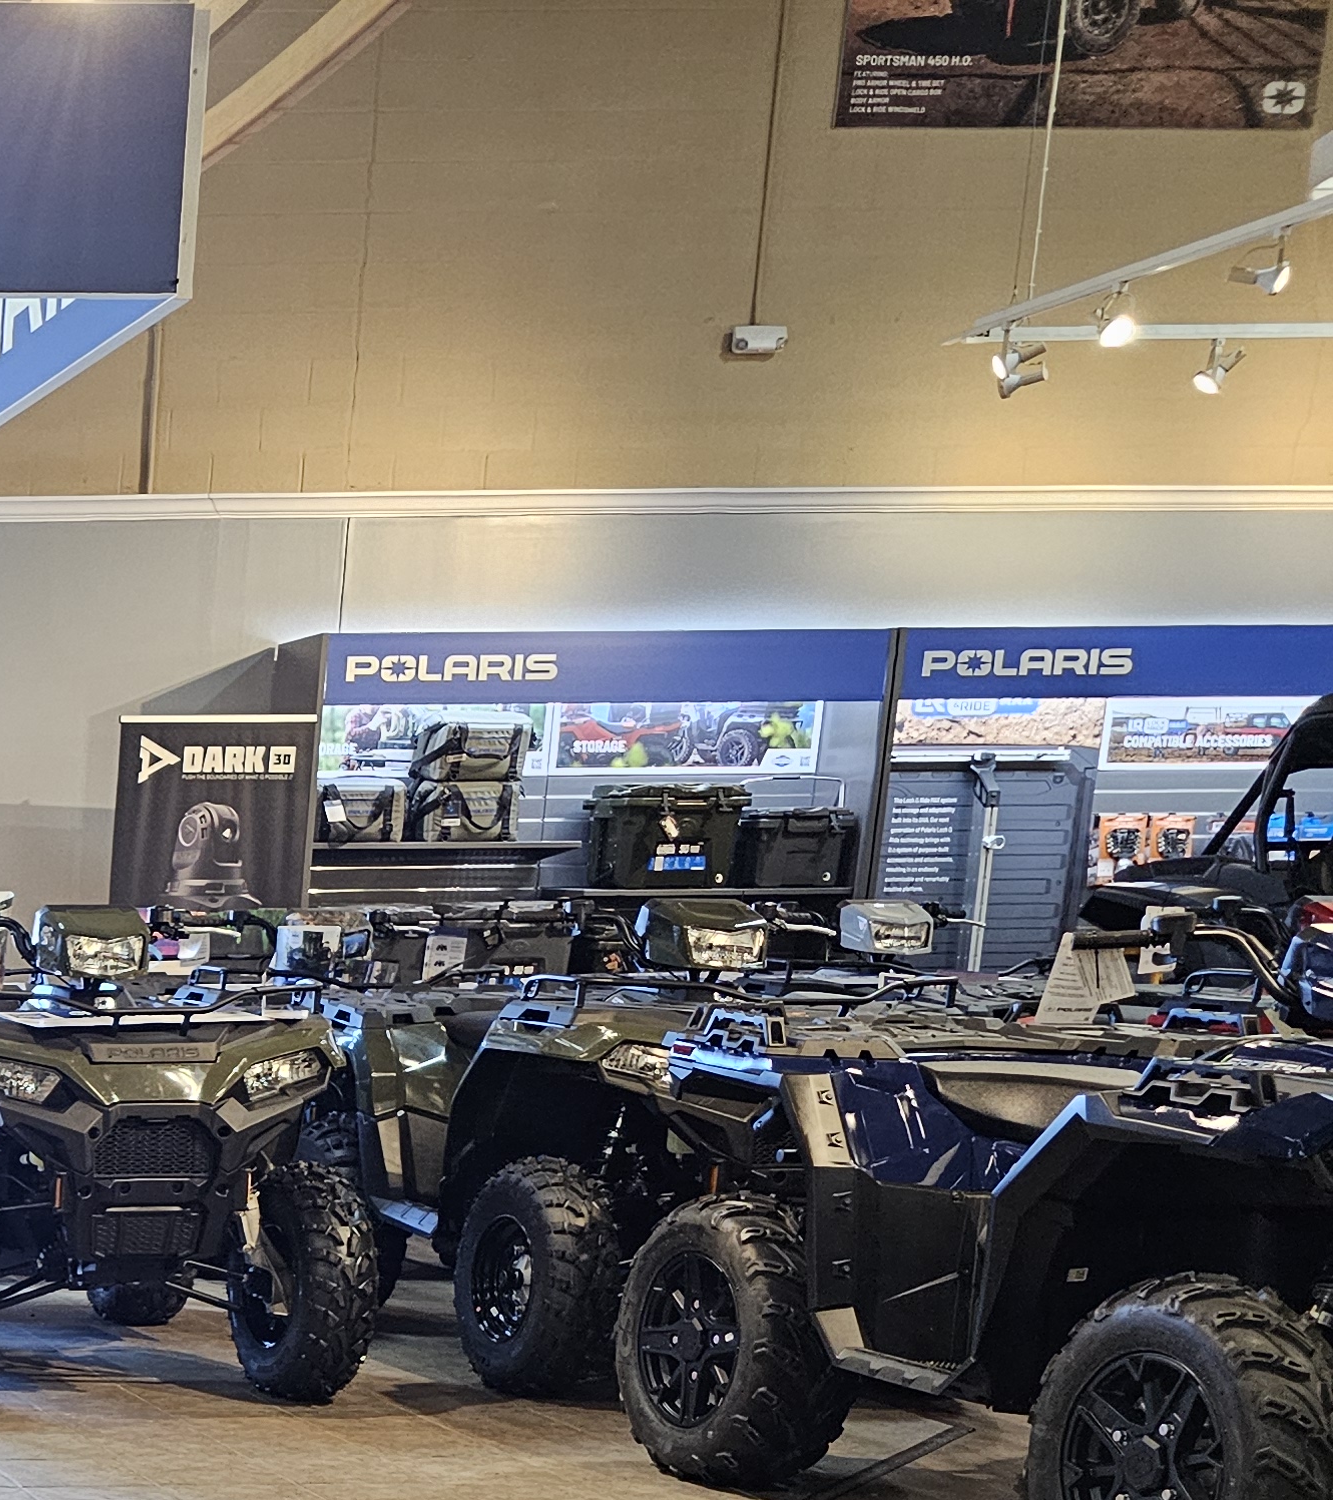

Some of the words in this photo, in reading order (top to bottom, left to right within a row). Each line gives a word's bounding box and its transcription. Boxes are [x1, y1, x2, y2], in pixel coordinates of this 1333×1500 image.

[856, 55, 925, 66] SPORTSMAN
[928, 55, 949, 66] 450
[345, 654, 558, 682] POLARIS
[920, 647, 1133, 677] POLARIS
[573, 740, 627, 753] STORAGE
[1123, 735, 1193, 748] COMPATIBLE
[1196, 734, 1273, 748] ACCESSORIES
[319, 743, 357, 755] ORAGE
[183, 746, 266, 773] DARK
[106, 1046, 200, 1059] POLARIS
